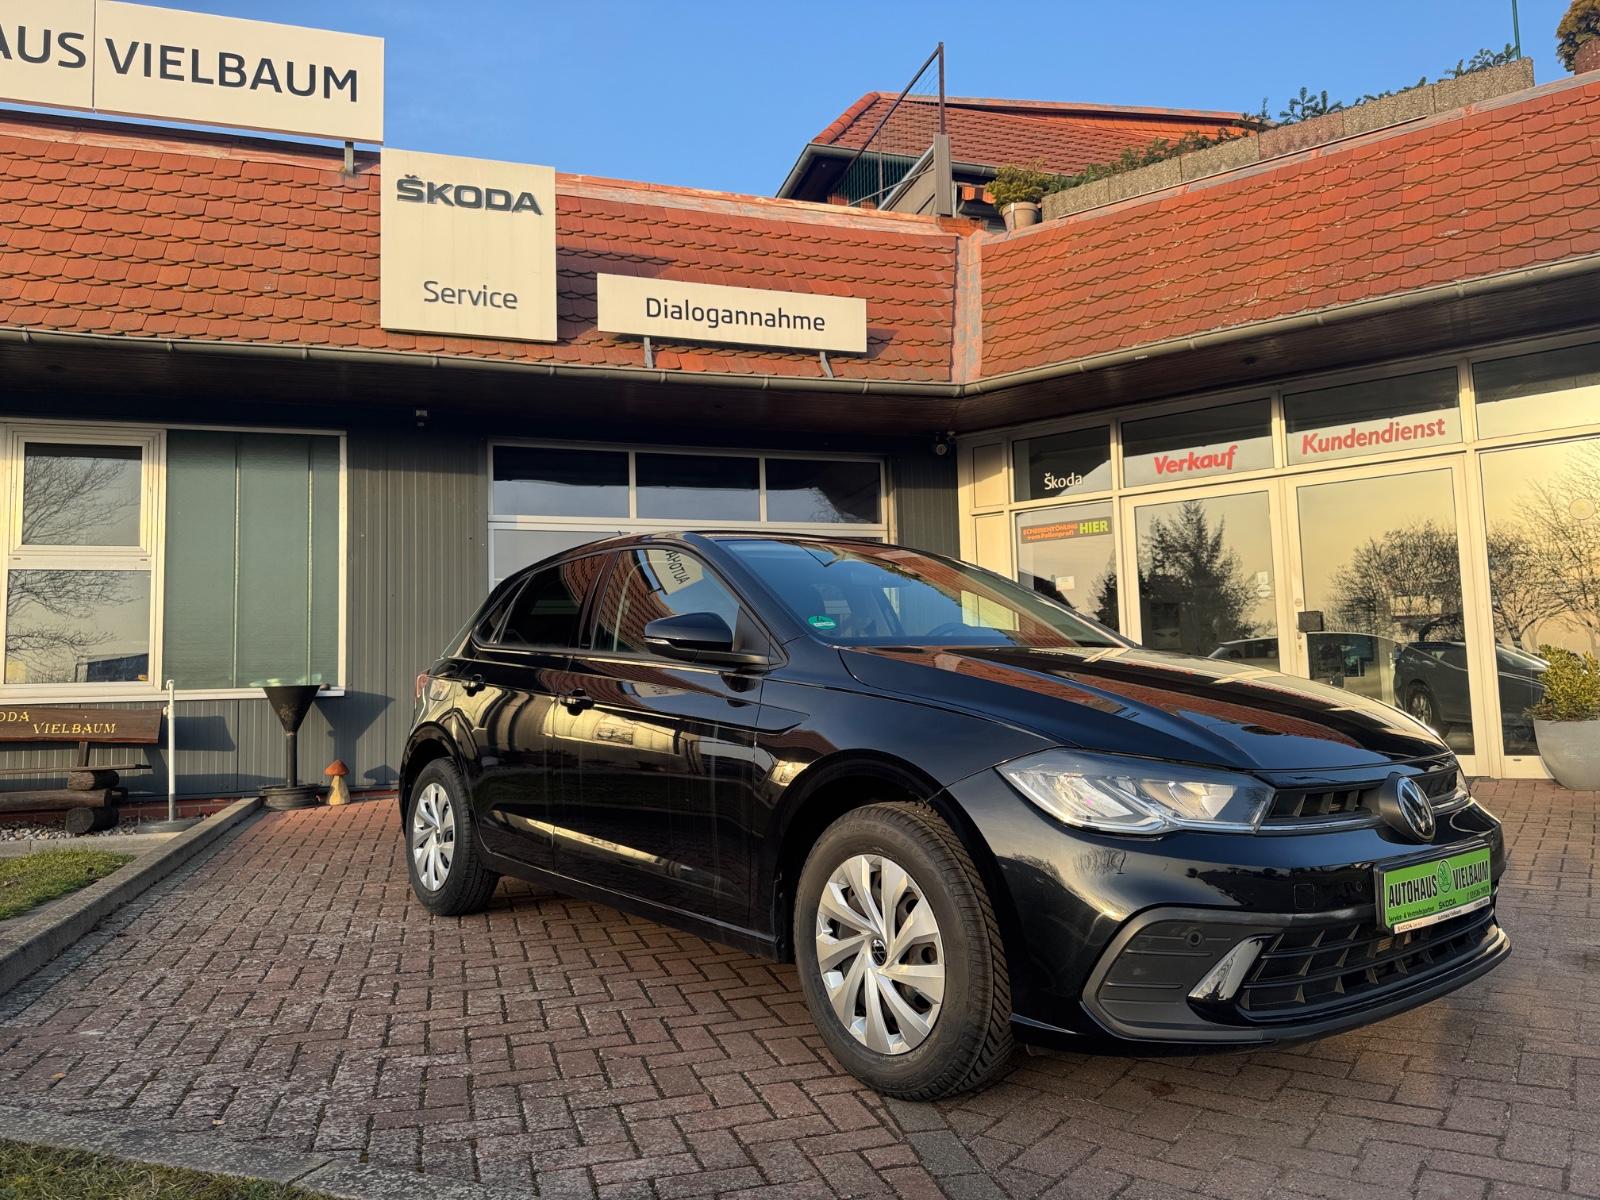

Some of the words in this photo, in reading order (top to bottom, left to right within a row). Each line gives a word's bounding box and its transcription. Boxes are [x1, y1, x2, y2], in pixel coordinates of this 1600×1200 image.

[105, 38, 358, 102] VIELBAUM
[396, 174, 543, 216] ŠKODA
[423, 280, 518, 310] Service
[646, 297, 825, 331] Dialogannahme
[1301, 418, 1446, 455] Kundendienst
[1154, 445, 1239, 475] Verkauf
[1043, 472, 1083, 490] Škoda
[1080, 520, 1109, 534] HIER
[33, 722, 116, 734] VIELBAUM
[1388, 875, 1438, 908] AUTOHAUS
[1452, 860, 1489, 890] VIELBAUM
